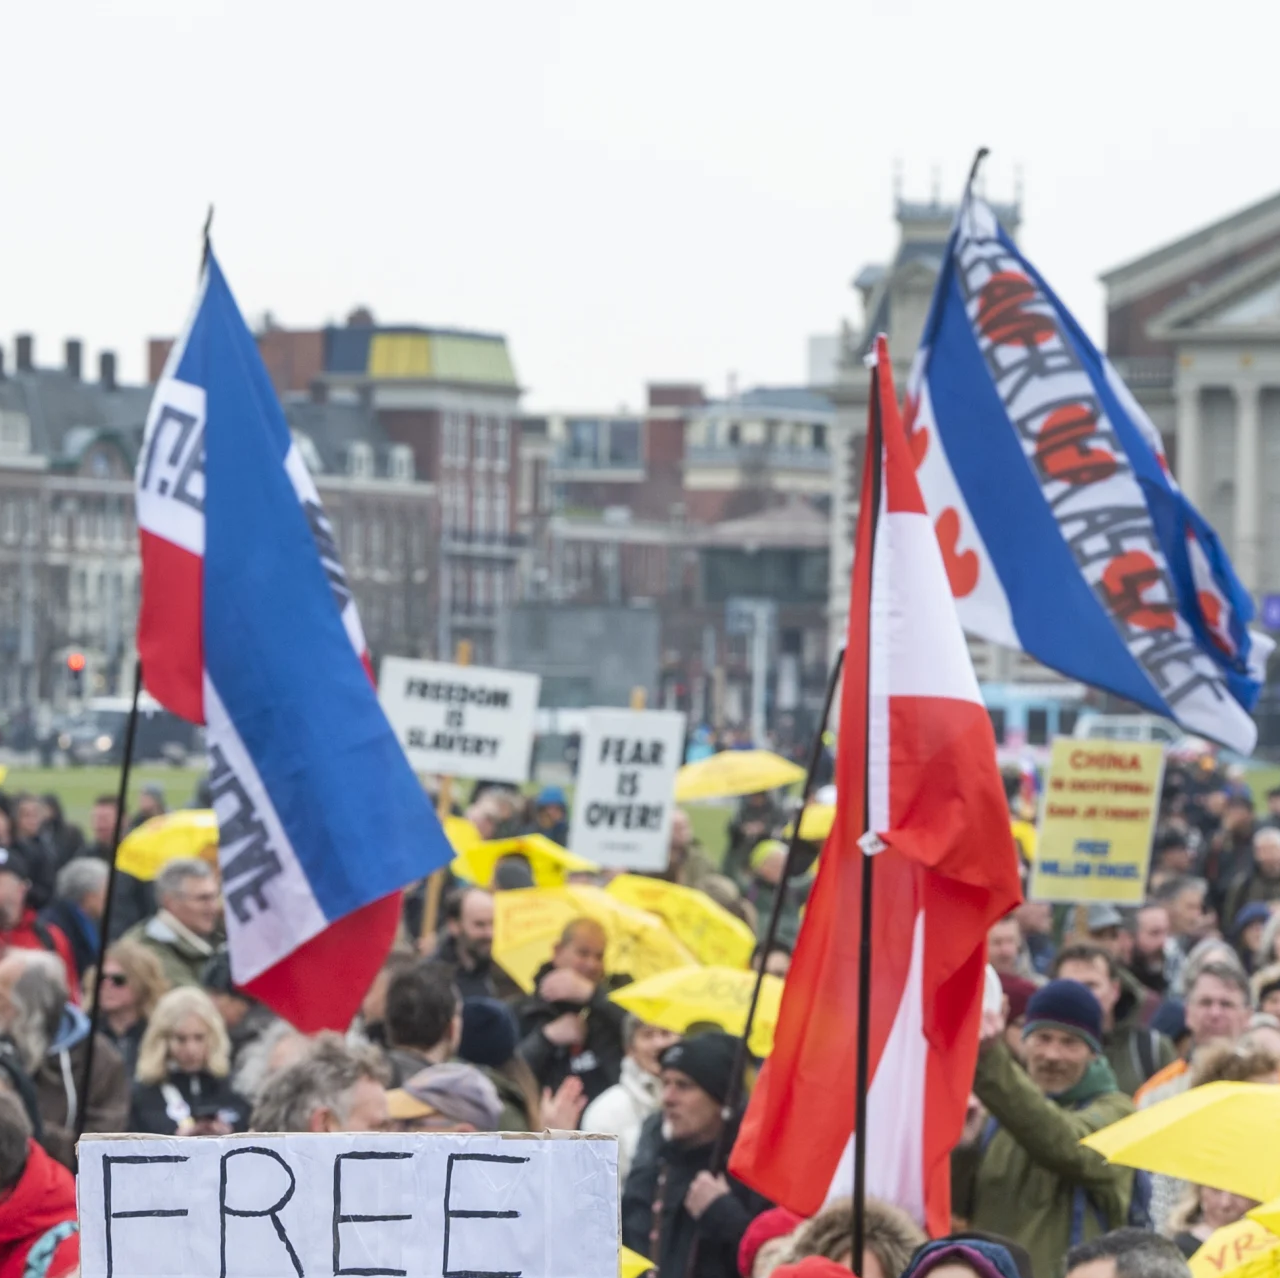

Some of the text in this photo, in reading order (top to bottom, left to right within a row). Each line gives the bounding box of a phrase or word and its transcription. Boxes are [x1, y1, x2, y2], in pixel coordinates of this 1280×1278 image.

[405, 678, 511, 708] FREEDOM
[445, 707, 464, 727] IS
[406, 729, 501, 757] SLAVERY
[600, 737, 664, 766] FEAR
[1070, 750, 1141, 772] CHINA
[617, 771, 641, 798] IS
[586, 802, 663, 832] OVER!
[1075, 839, 1110, 856] FREE
[1040, 860, 1139, 879] WILLEM ENGEL
